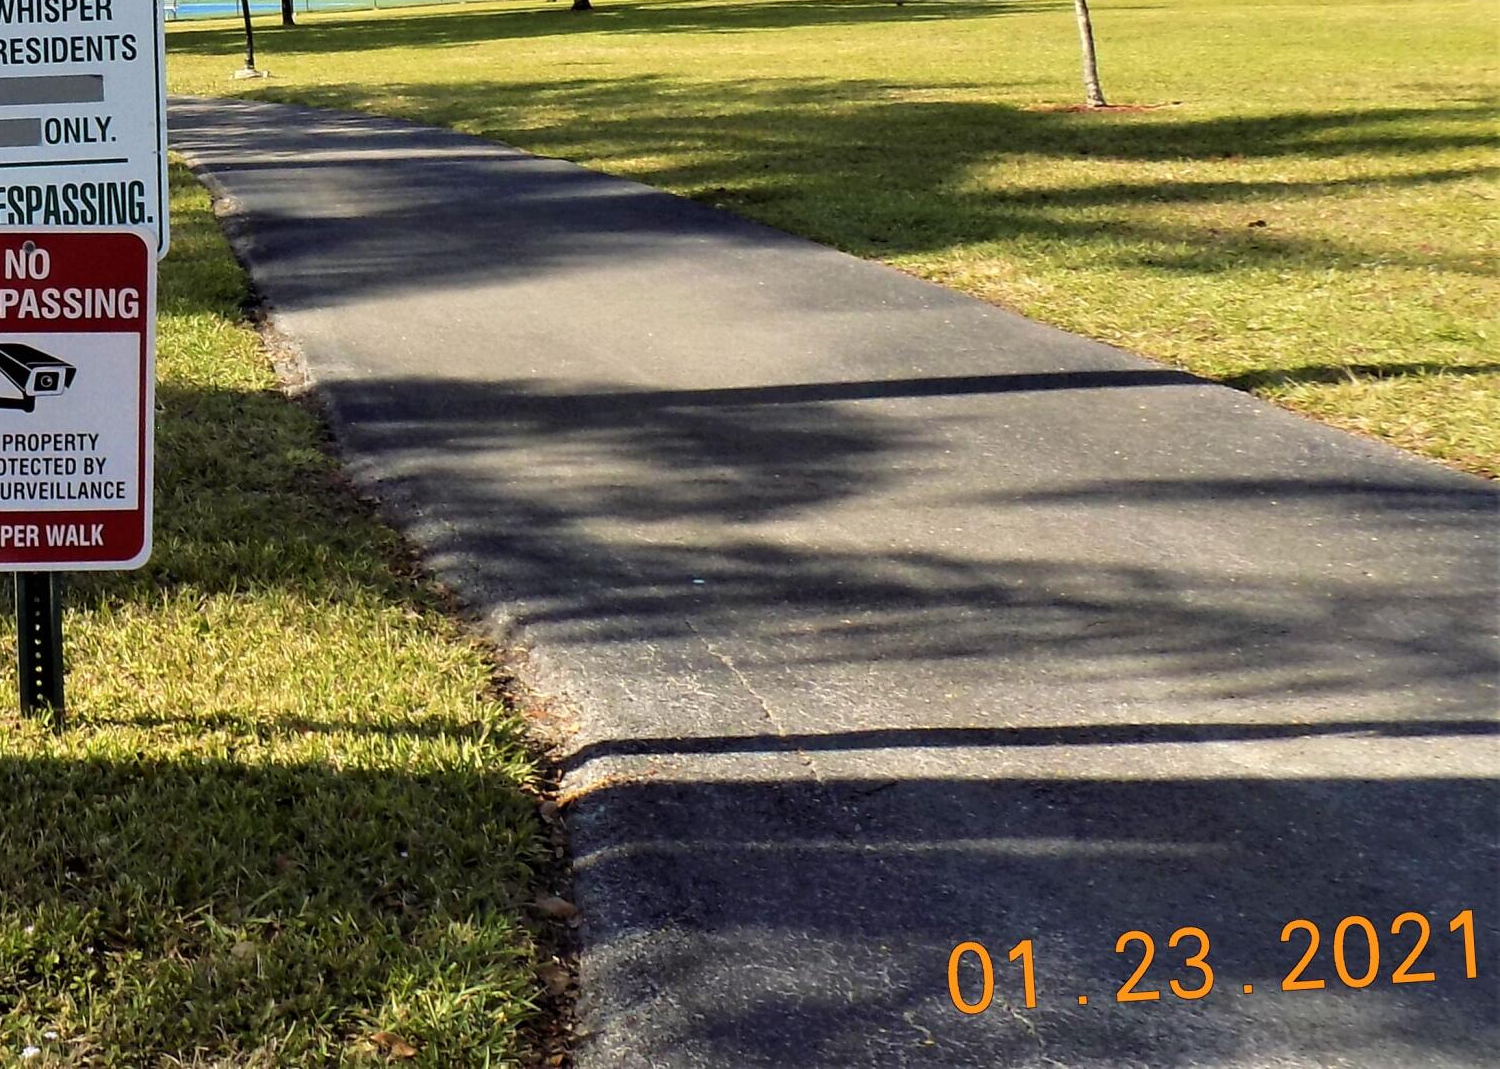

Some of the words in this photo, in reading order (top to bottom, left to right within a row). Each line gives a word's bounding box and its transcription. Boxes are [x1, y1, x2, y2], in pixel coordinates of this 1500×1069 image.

[44, 116, 117, 145] ONLY.
[5, 248, 50, 280] NO
[2, 433, 99, 452] PROPERTY
[83, 457, 107, 475] BY
[46, 524, 104, 547] WALK
